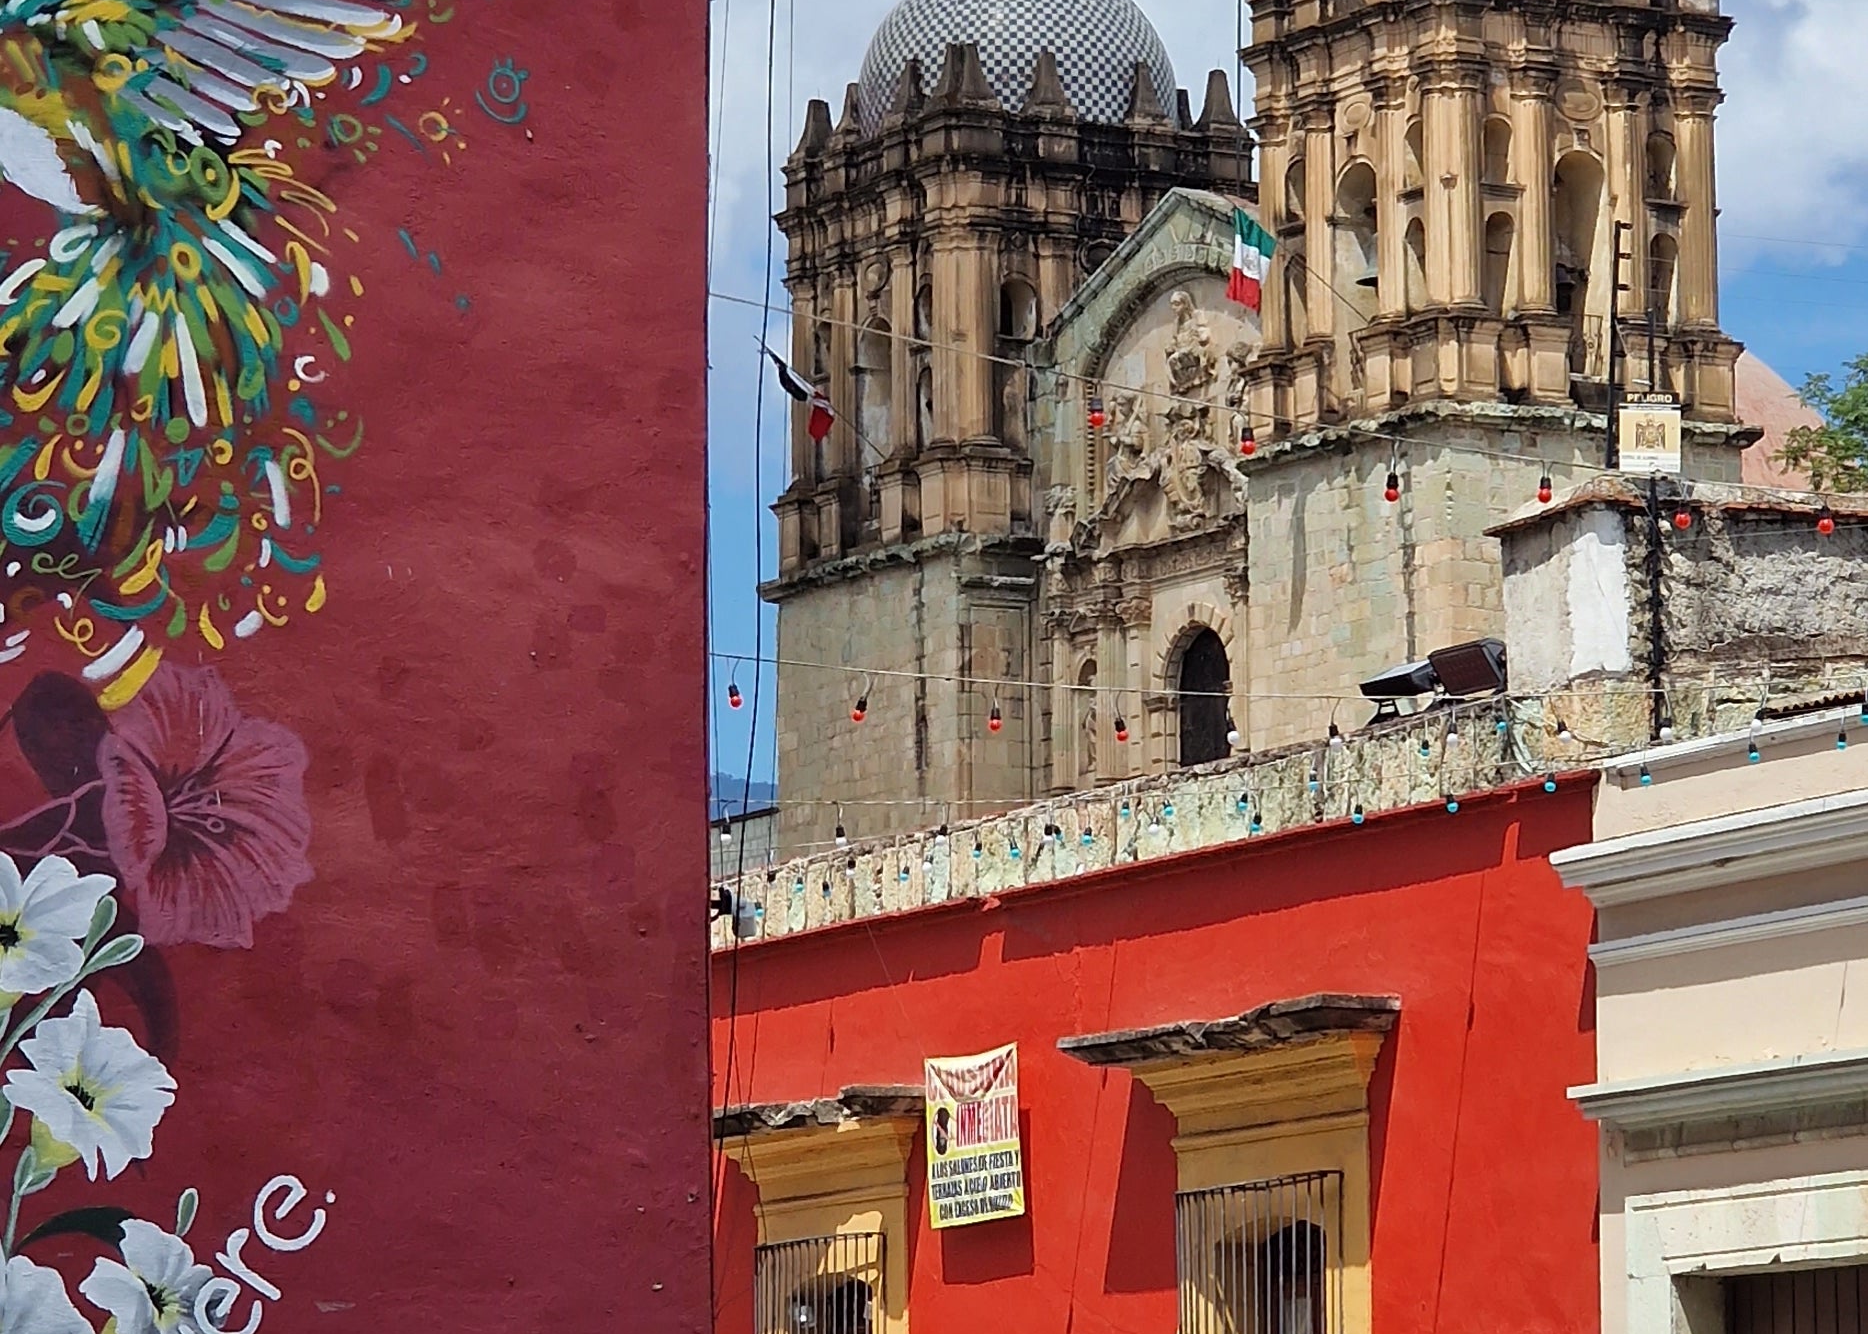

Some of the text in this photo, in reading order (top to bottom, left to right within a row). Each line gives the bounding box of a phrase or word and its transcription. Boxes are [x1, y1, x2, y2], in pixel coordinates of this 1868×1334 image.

[1627, 393, 1673, 403] PELIGRO
[978, 1154, 988, 1171] DE
[989, 1151, 1013, 1170] FIESTA
[989, 1170, 1021, 1191] ABIERTO
[939, 1203, 953, 1220] CON
